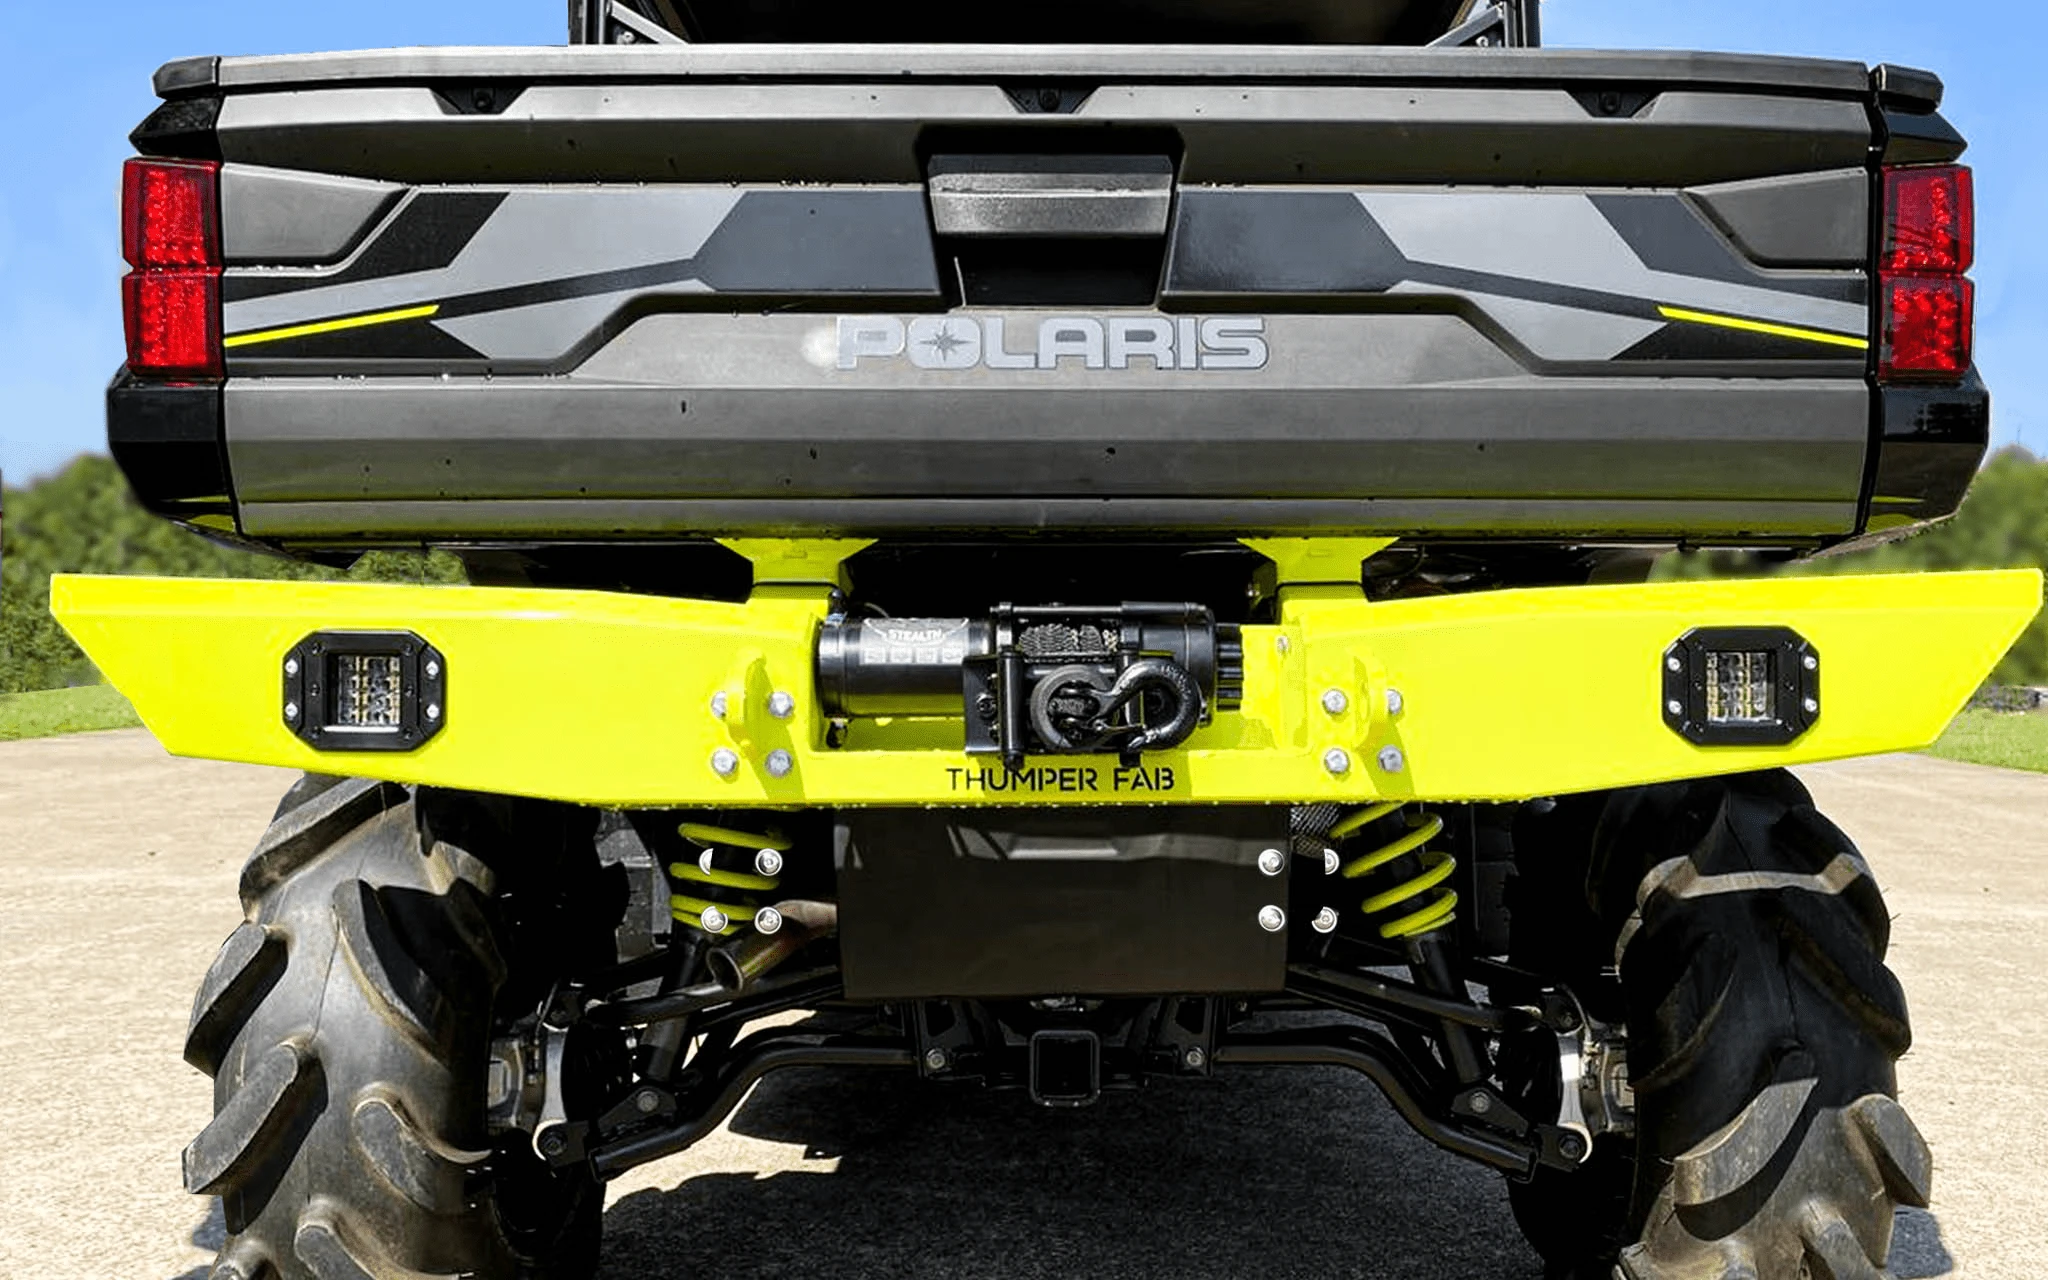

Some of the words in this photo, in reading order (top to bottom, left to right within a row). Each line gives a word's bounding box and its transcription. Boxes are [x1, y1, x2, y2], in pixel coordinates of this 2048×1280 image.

[836, 316, 1268, 371] POLARIS
[946, 768, 1098, 791] THUMPER
[1113, 768, 1175, 791] FAB
